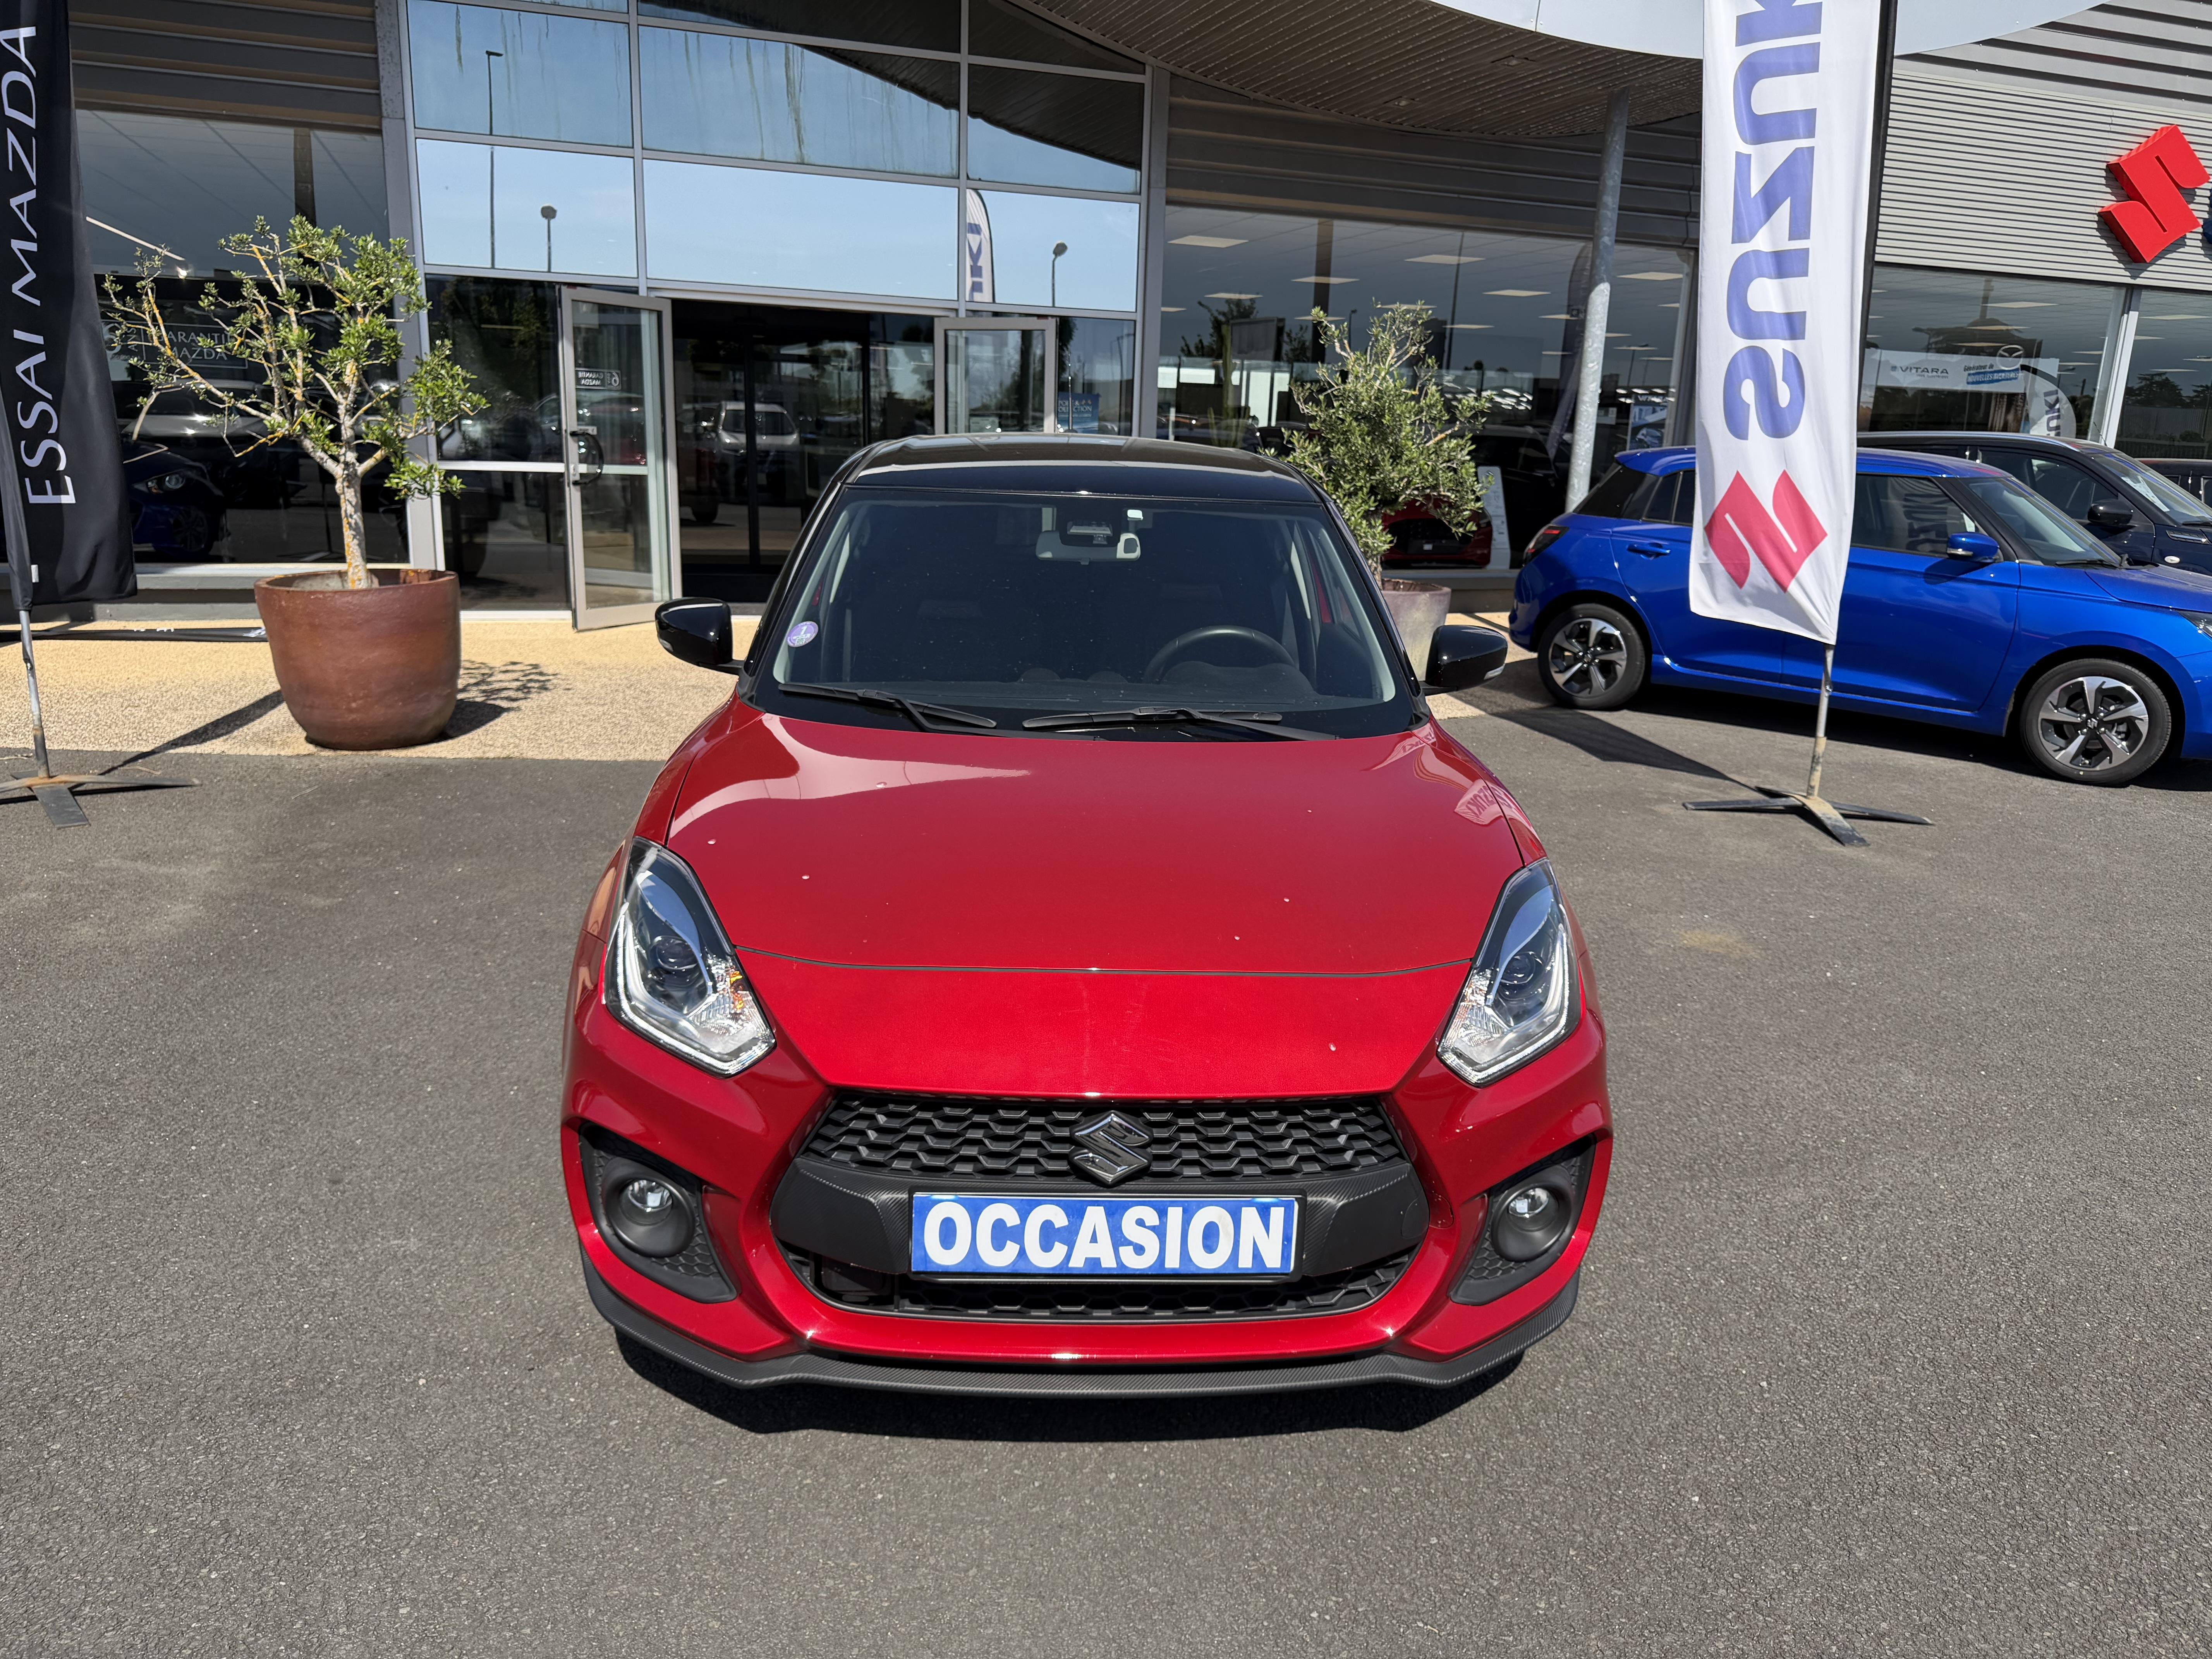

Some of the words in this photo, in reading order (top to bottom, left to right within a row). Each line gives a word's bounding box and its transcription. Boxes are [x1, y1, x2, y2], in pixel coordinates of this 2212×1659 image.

[0, 26, 41, 306] MAZDA
[158, 331, 235, 345] ARANTI
[1899, 366, 1949, 374] VITARA
[14, 329, 76, 504] ESSAI
[801, 626, 807, 635] 1
[924, 1200, 1285, 1270] OCCASION
